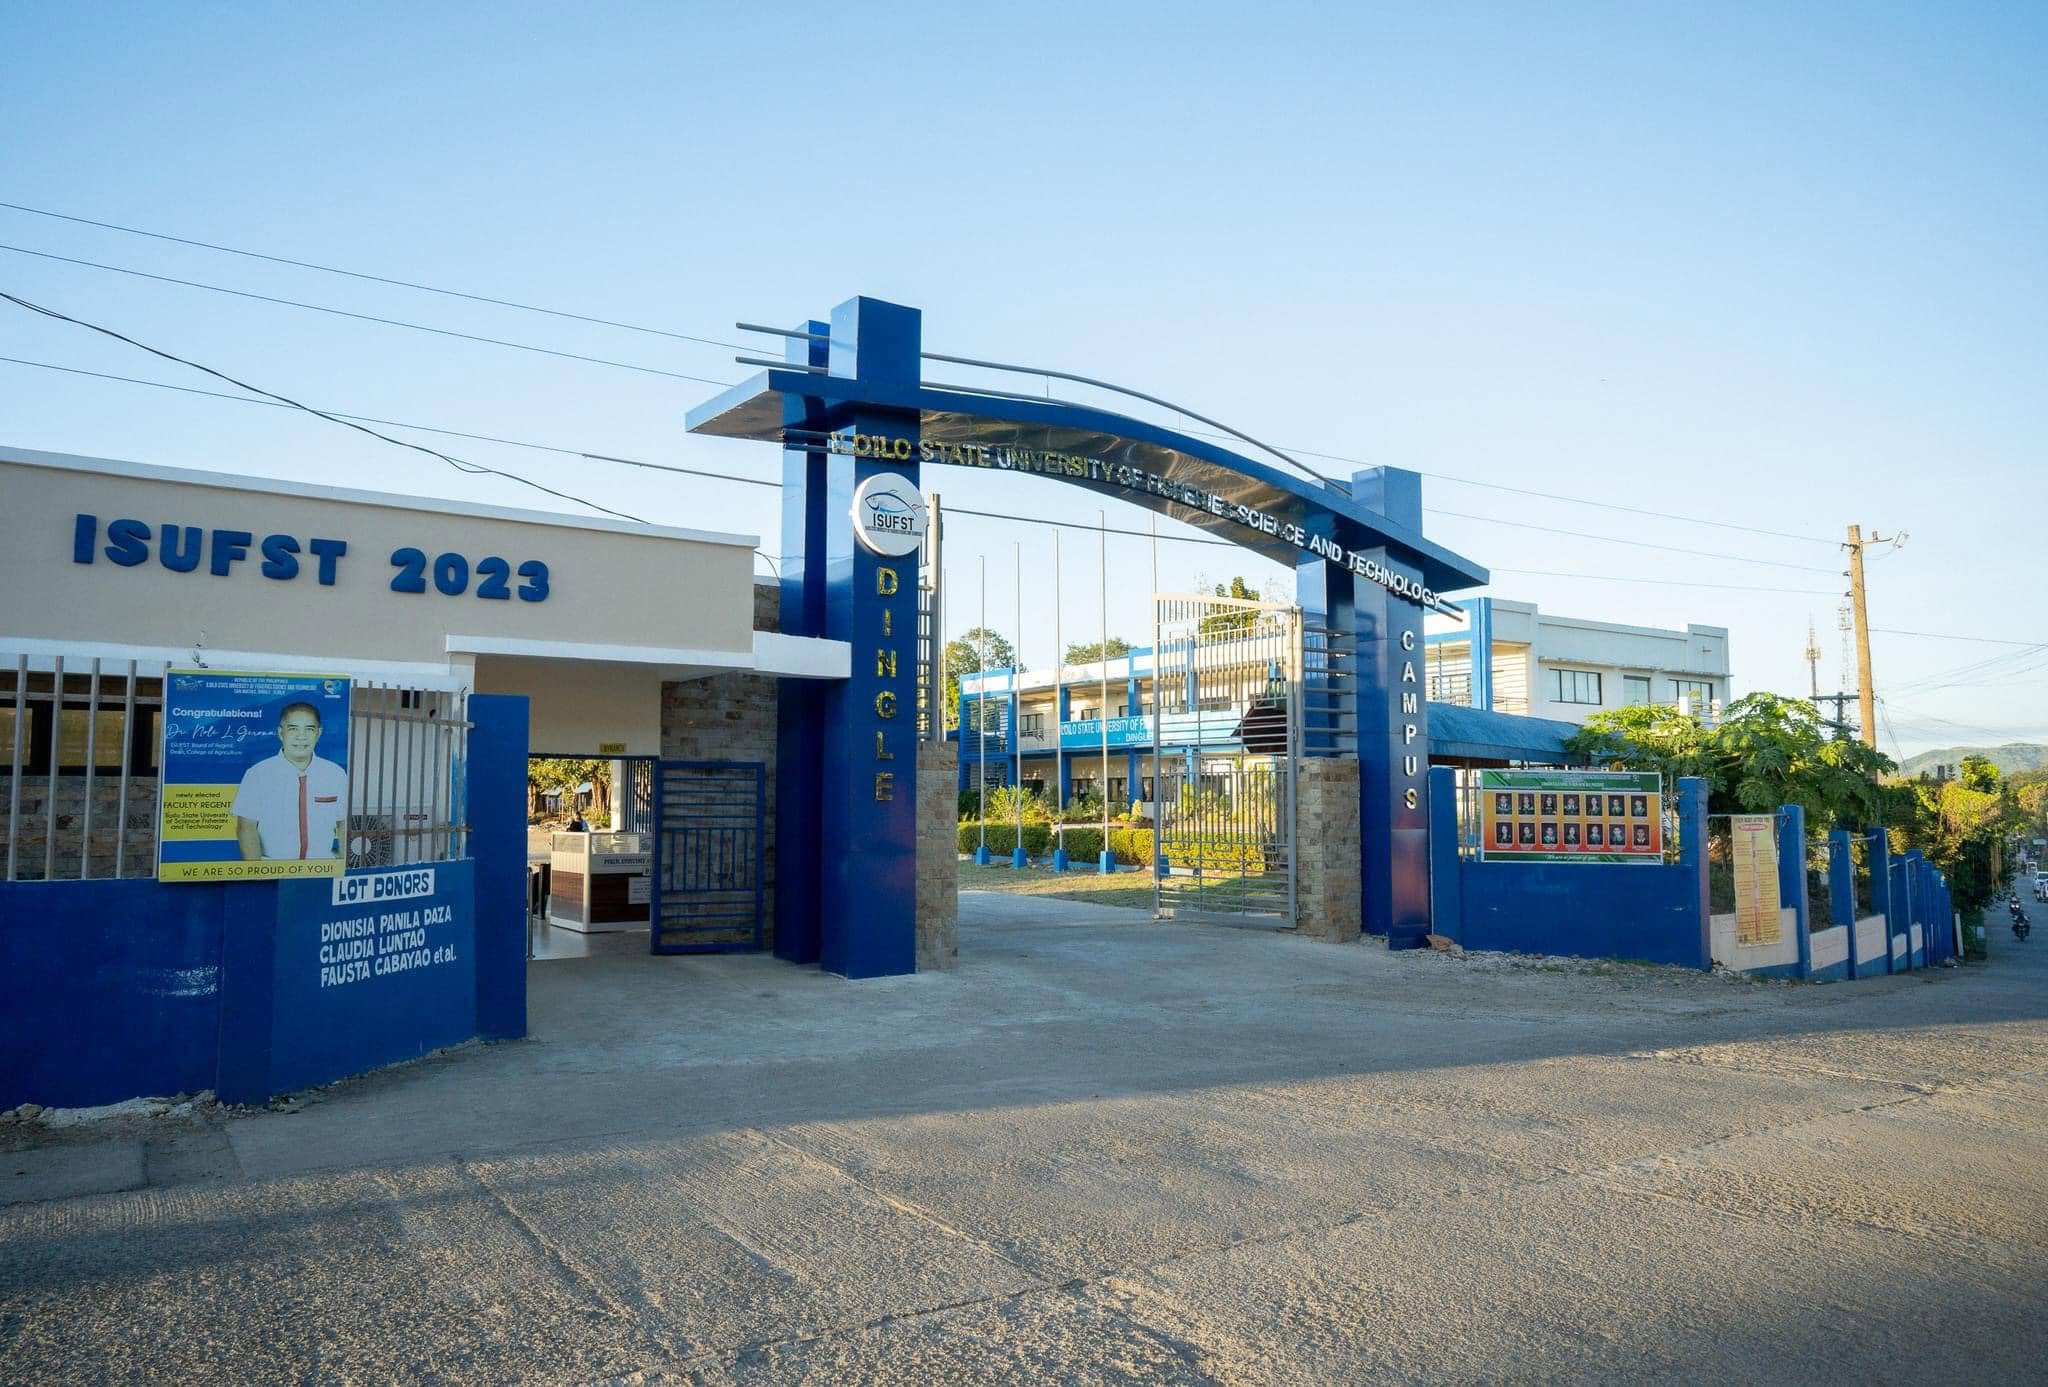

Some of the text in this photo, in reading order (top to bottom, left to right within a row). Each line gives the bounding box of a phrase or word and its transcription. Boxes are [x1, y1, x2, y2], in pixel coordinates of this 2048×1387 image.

[873, 513, 914, 531] ISUFST
[918, 439, 992, 468] STATE
[997, 447, 1114, 482] UNIVERSITY
[1117, 465, 1143, 487] OF
[1237, 505, 1305, 547] SCIENCE
[1310, 534, 1342, 562] AND
[1347, 551, 1441, 609] TECHNOLOGY
[73, 513, 550, 603] ISUFST 2023
[875, 566, 898, 801] DINGLE
[172, 707, 263, 719] Congratulations!
[1077, 722, 1095, 735] STATE
[1402, 630, 1418, 810] CAMPUS
[182, 864, 333, 877] WE ARE SO PROUD OF YOU!
[338, 872, 430, 902] LOT DONORS
[321, 905, 452, 943] DIONISIA PANILA DAZA
[319, 928, 426, 964] CLAUDIA LUNTAO
[320, 960, 371, 988] FAUSTA
[375, 948, 431, 976] CABAYAO
